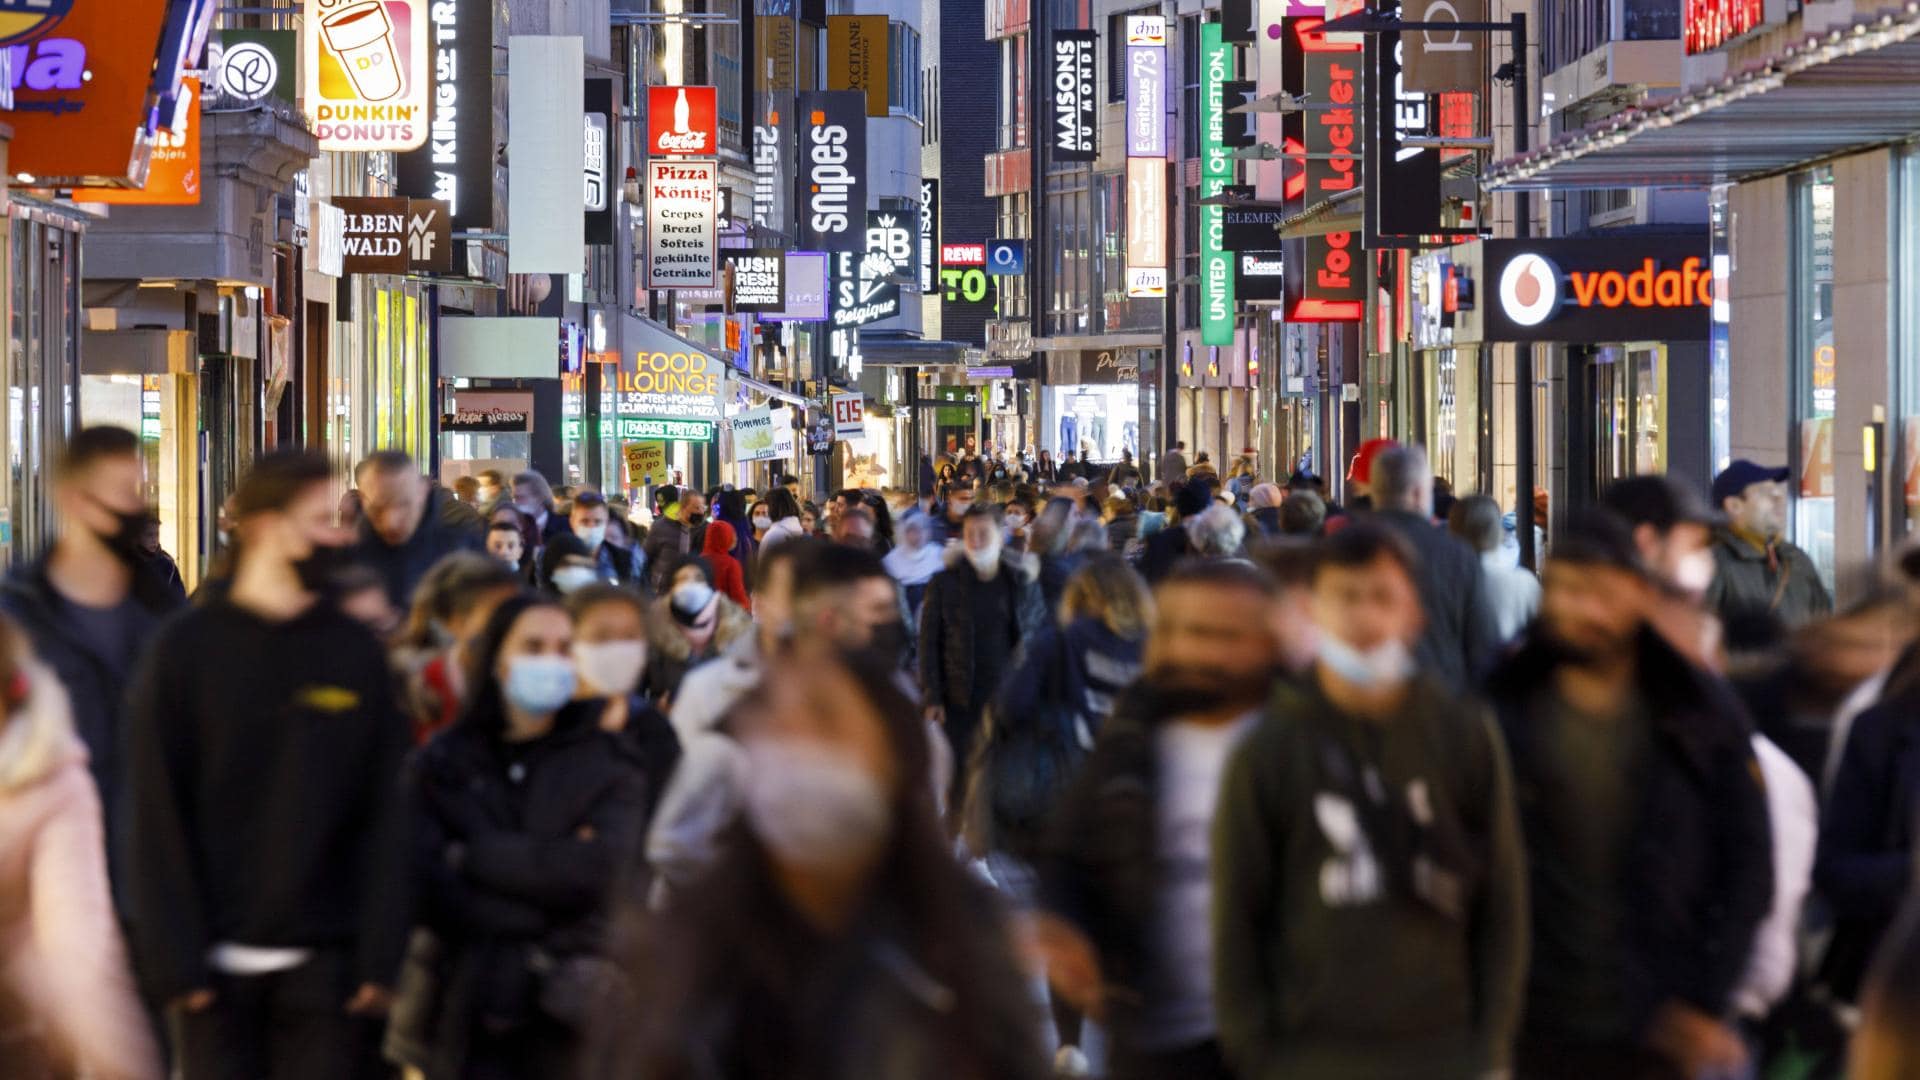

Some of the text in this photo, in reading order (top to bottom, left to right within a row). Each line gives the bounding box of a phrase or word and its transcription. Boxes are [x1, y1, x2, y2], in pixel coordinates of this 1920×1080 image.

[432, 0, 457, 45] TR
[1135, 20, 1160, 35] dm
[1056, 40, 1076, 151] MAISONS
[1081, 40, 1092, 151] DU MONDE
[1134, 51, 1157, 152] Eventhaus 73
[317, 104, 419, 121] DUNKIN'
[432, 83, 457, 163] KING
[1320, 63, 1354, 190] Locker
[317, 123, 414, 141] DONUTS
[150, 149, 186, 161] objets
[1210, 147, 1226, 173] OF
[657, 166, 708, 180] Pizza
[811, 124, 856, 233] snipes
[654, 186, 711, 202] König
[661, 209, 704, 220] Crepes
[662, 224, 702, 234] Brezel
[341, 236, 403, 258] WALD
[660, 238, 704, 249] Softeis
[654, 253, 710, 265] gekühlte
[943, 246, 983, 262] REWE
[1317, 231, 1350, 288] Foo
[652, 267, 711, 278] Getränke
[735, 272, 779, 287] RESH
[1135, 271, 1160, 286] dm
[941, 268, 987, 302] TO
[1210, 257, 1226, 321] UNITED
[834, 298, 896, 326] Belgique
[636, 352, 708, 374] FOOD
[624, 371, 719, 395] LOUNGE
[627, 392, 666, 404] SOFTEIS
[836, 400, 863, 423] EIS
[629, 423, 706, 438] PAPAS FRITAS
[733, 416, 771, 430] Pommes
[628, 449, 662, 461] Coffee
[631, 461, 660, 471] to go
